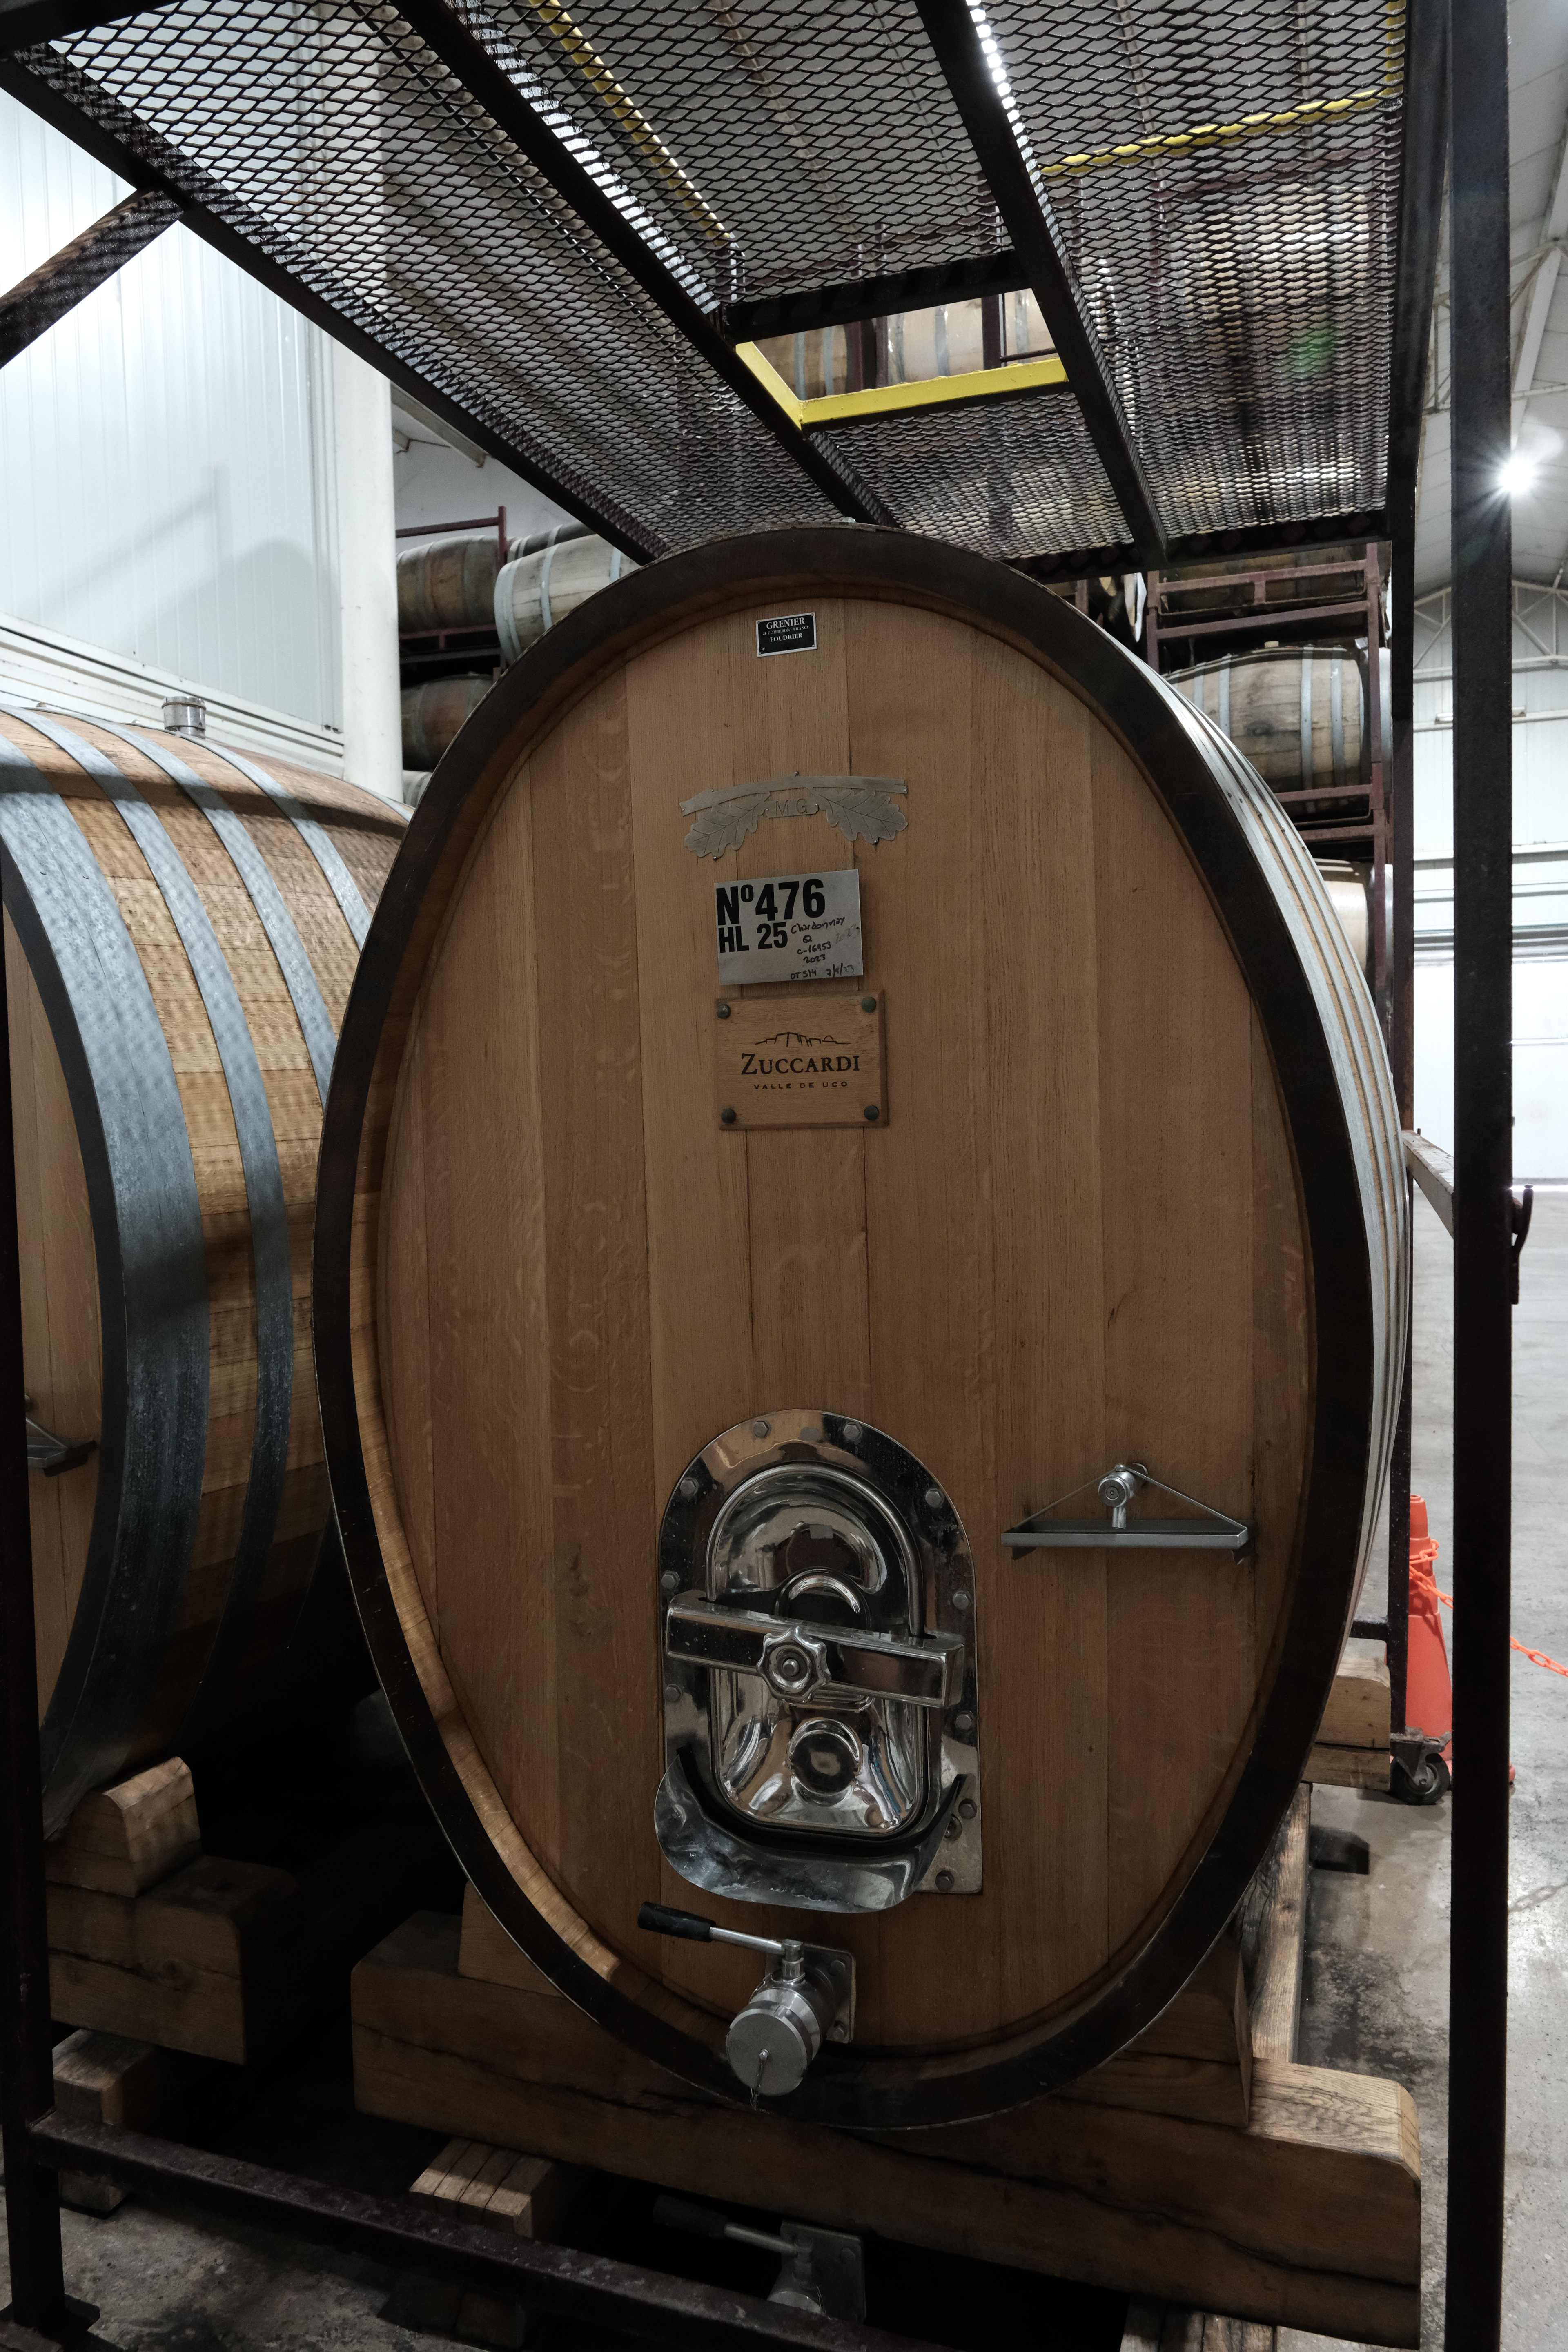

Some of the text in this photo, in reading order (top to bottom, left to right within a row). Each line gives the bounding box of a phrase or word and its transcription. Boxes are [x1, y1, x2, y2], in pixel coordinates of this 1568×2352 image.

[766, 617, 805, 629] GRENIER
[770, 633, 803, 642] FOUDRIER
[791, 917, 845, 934] Chardonnay
[718, 922, 788, 953] HL 25
[803, 953, 826, 963] 2023
[741, 1053, 860, 1075] ZUCCARDI
